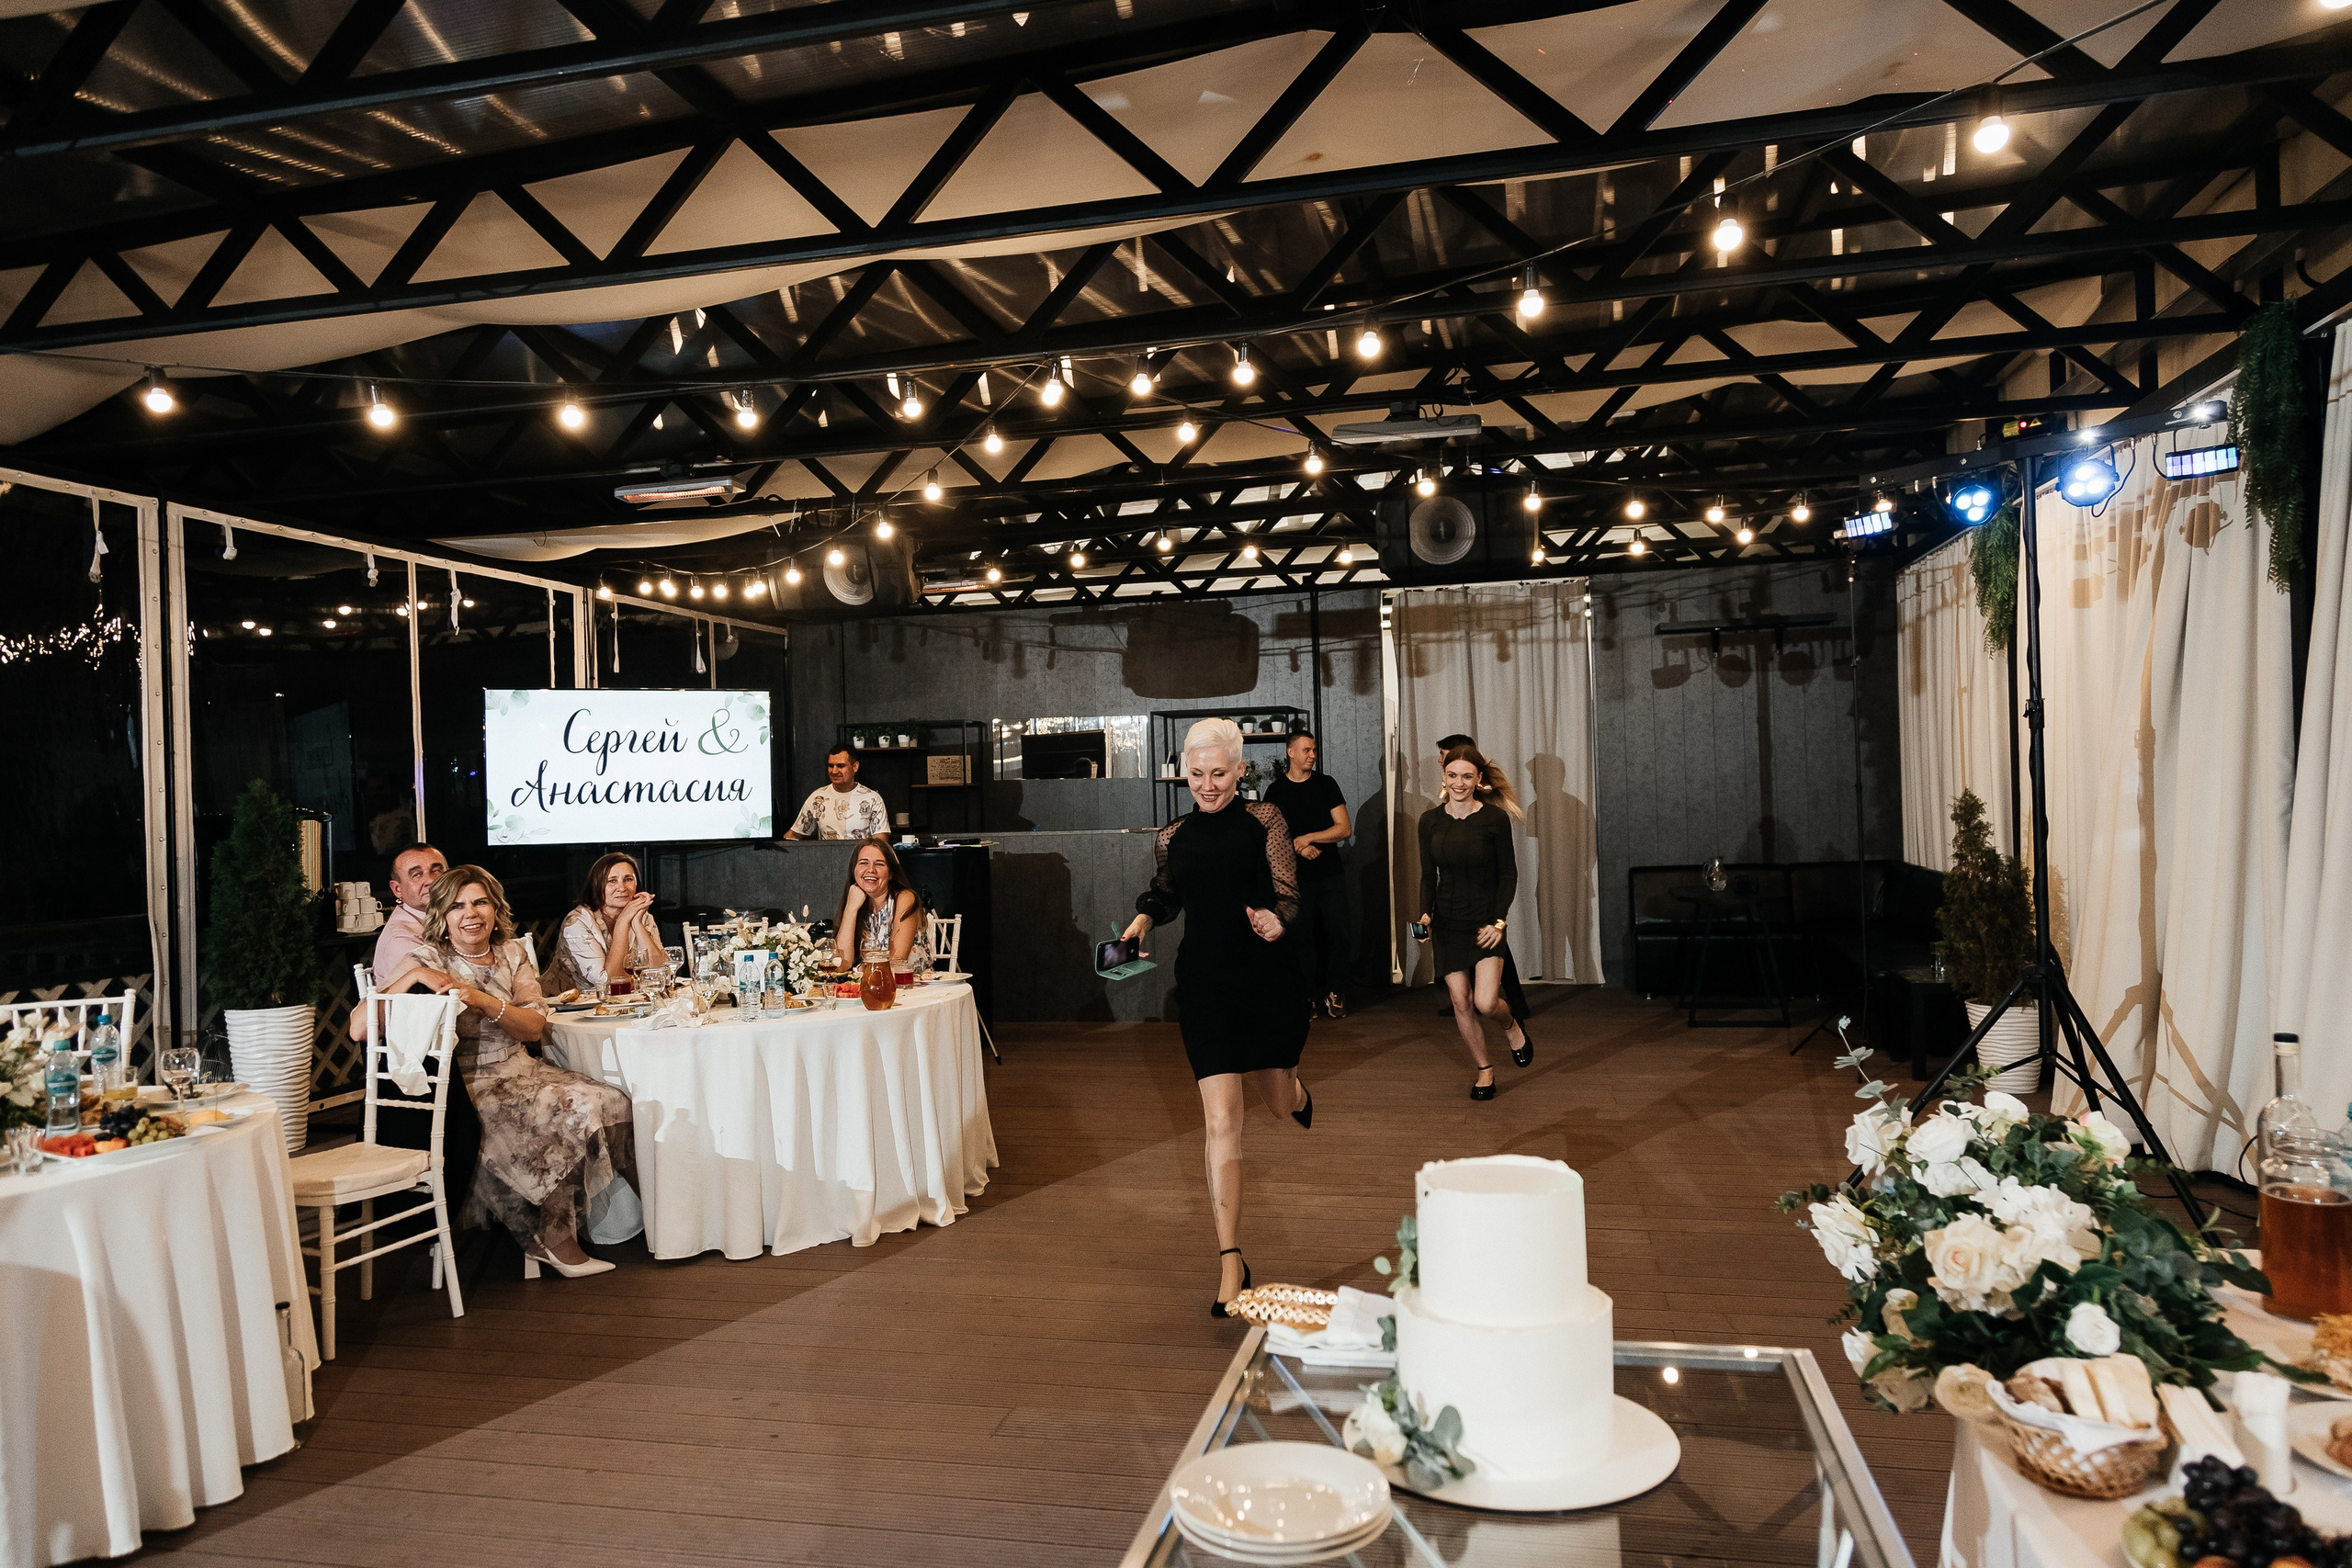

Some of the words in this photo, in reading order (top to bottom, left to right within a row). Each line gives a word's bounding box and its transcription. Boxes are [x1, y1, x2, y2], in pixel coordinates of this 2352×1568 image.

[563, 708, 688, 776] Сергей
[697, 708, 749, 756] &
[511, 760, 752, 814] Анастасия
